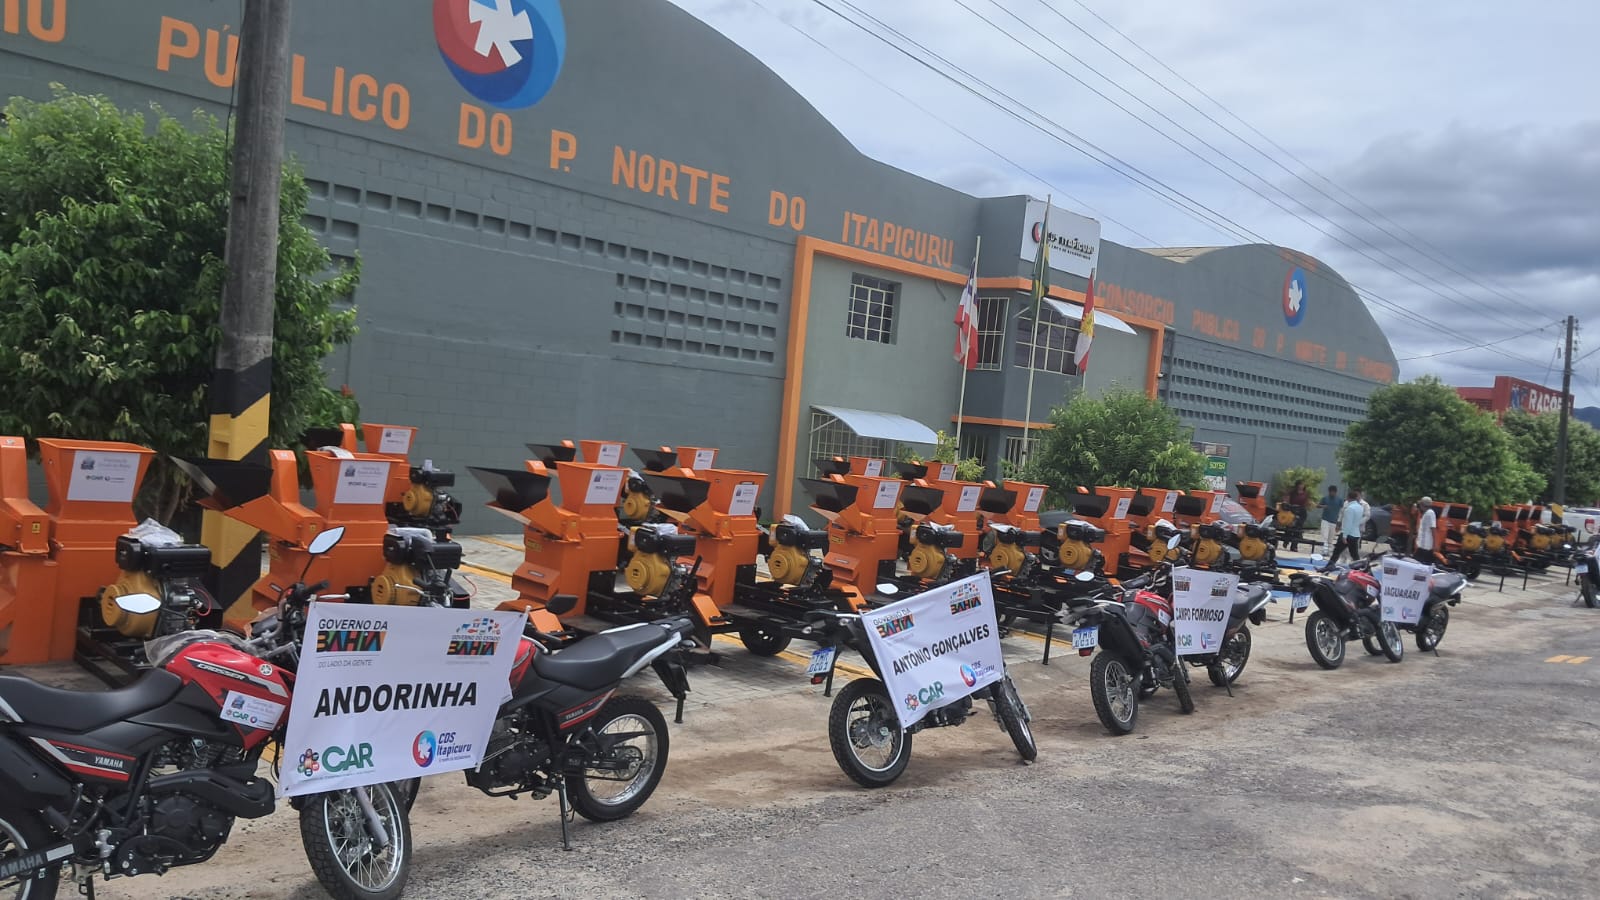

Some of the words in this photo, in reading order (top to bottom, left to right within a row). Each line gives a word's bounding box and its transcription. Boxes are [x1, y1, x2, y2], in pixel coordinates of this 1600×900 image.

[156, 15, 411, 131] PÚLICO
[458, 102, 512, 156] DO
[549, 129, 577, 172] P.
[611, 145, 730, 213] NORTE
[768, 190, 805, 231] DO
[842, 211, 954, 268] ITAPICURU
[1384, 585, 1420, 600] JAGUARARI
[950, 596, 982, 615] BAHIA
[1192, 608, 1225, 622] FORMOSO
[318, 619, 372, 635] GOVERNO
[373, 620, 388, 635] DA
[876, 614, 915, 638] BAHIA
[316, 631, 386, 652] BAHIA
[447, 641, 497, 655] BAHIA
[931, 624, 990, 658] GONÇALVES
[197, 663, 246, 681] CROSSER
[352, 659, 373, 671] GENTE
[314, 682, 477, 718] ANDORINHA
[918, 681, 944, 705] CAR
[438, 731, 456, 745] CDS
[321, 742, 374, 772] CAR
[437, 742, 472, 758] Itapicuru
[94, 755, 124, 768] YAMAHA
